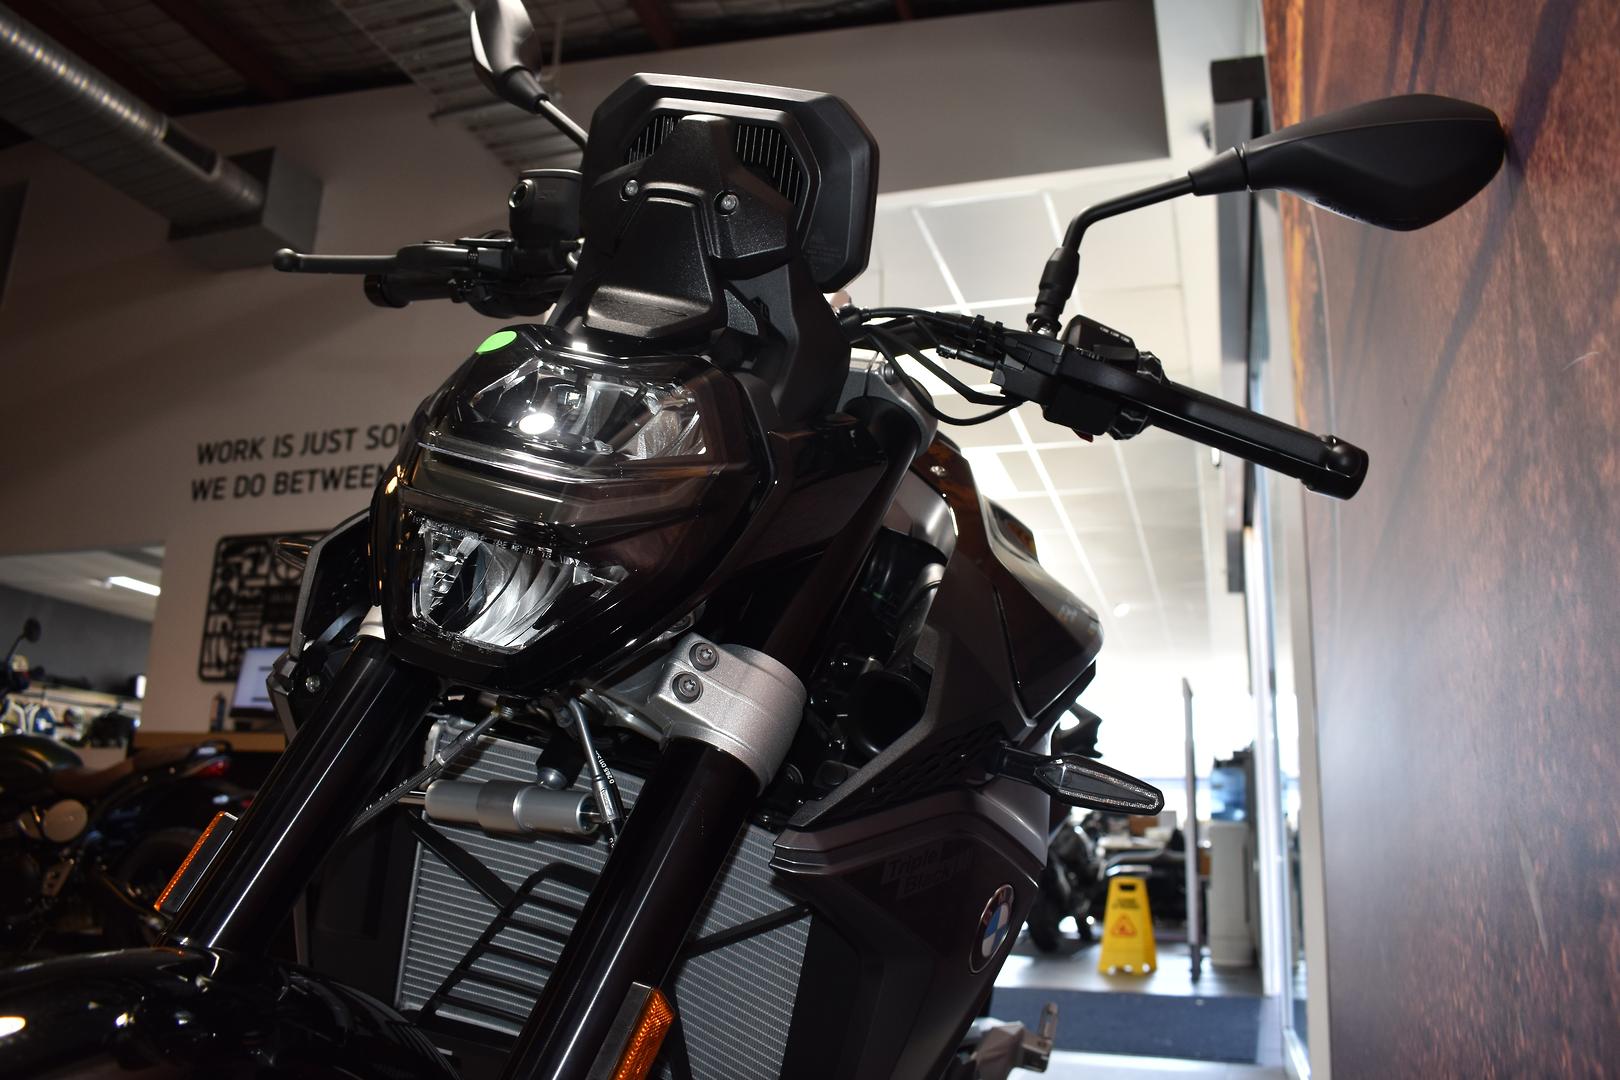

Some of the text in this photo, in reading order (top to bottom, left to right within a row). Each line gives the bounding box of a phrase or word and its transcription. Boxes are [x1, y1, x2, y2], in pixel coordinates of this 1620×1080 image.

[197, 424, 405, 464] WORK IS JUST SO
[191, 477, 226, 501] WE
[233, 474, 265, 499] DO
